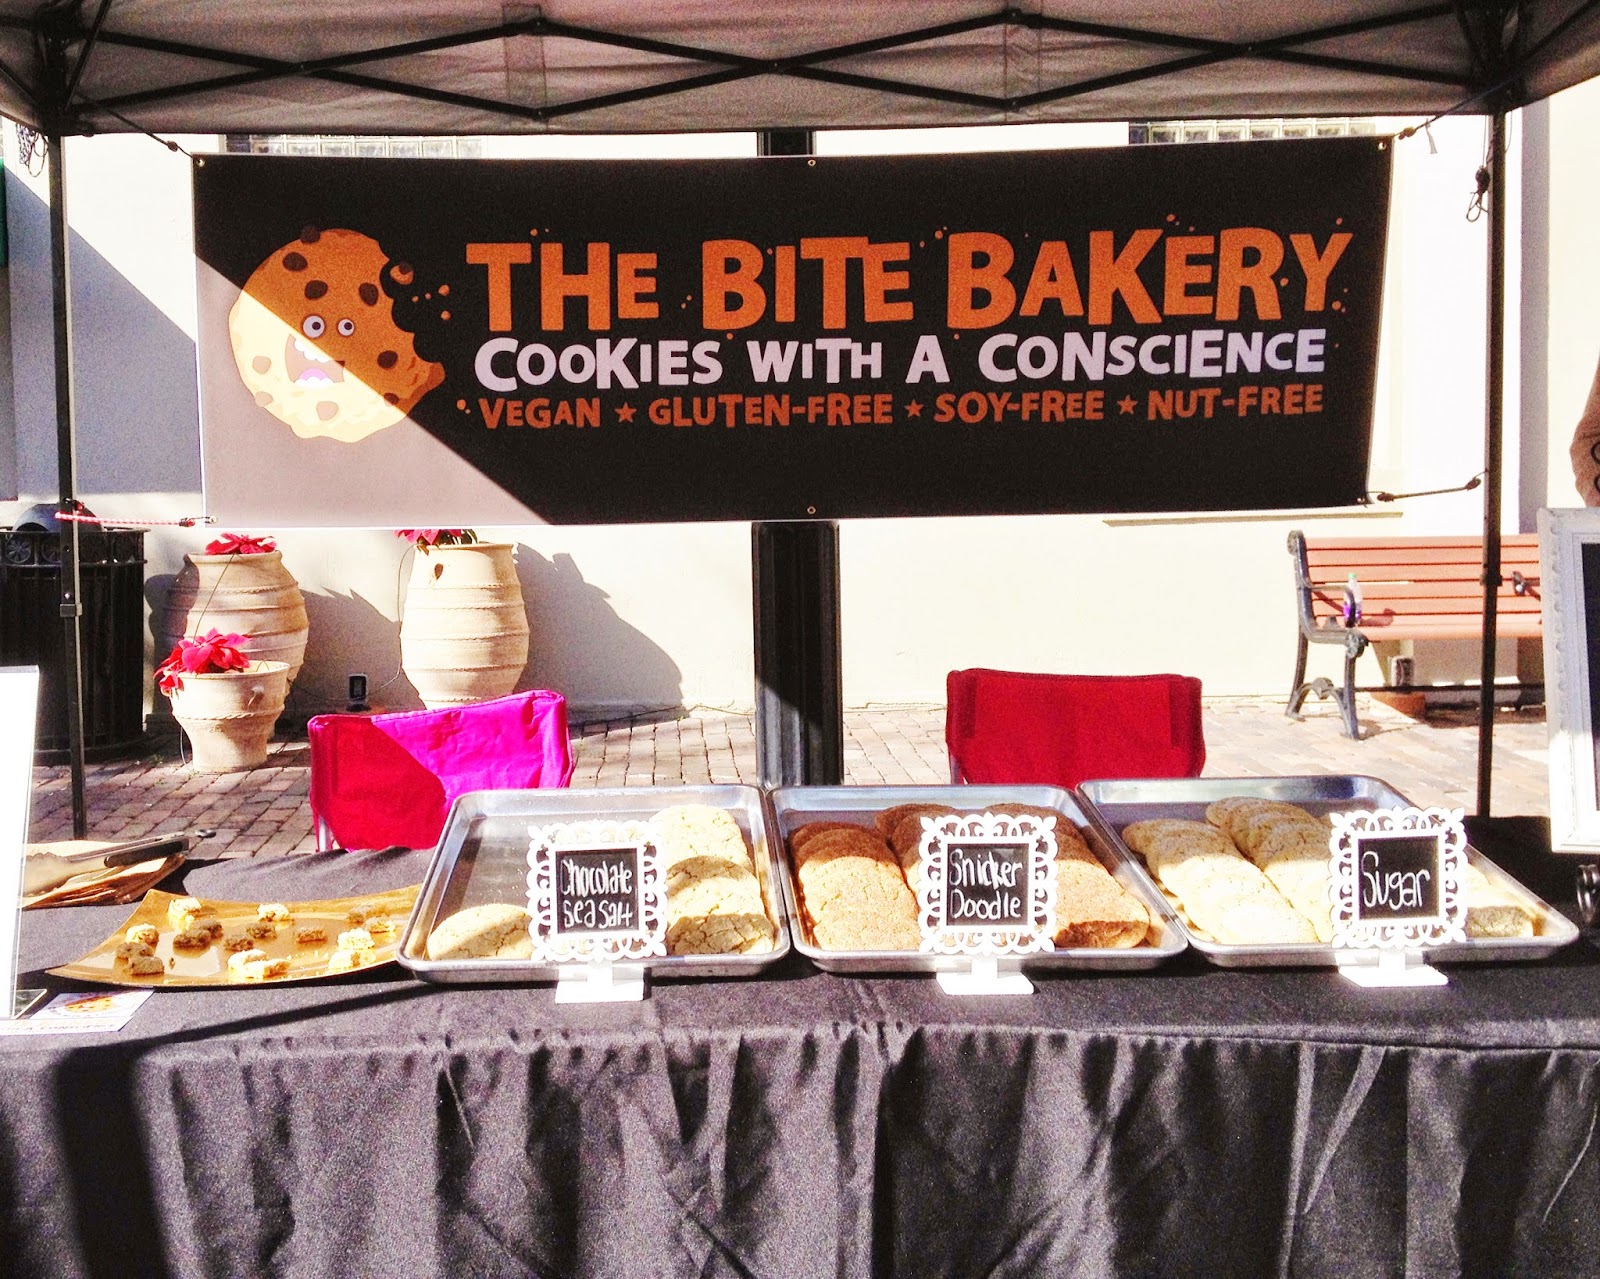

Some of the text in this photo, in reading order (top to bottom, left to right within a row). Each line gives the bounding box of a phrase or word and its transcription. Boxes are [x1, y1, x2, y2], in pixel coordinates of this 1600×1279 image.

[465, 227, 1354, 332] THE BITE BAKERY
[474, 328, 1327, 393] COOKIES WITH A CONSCIENCE
[478, 383, 1323, 429] VEGAN GLUTEN-FREE SOY-FREE NUT-FREE
[560, 857, 633, 898] Chocolate
[949, 848, 1023, 891] Snicker
[1361, 850, 1431, 911] Sugar
[950, 887, 1022, 920] Doodle
